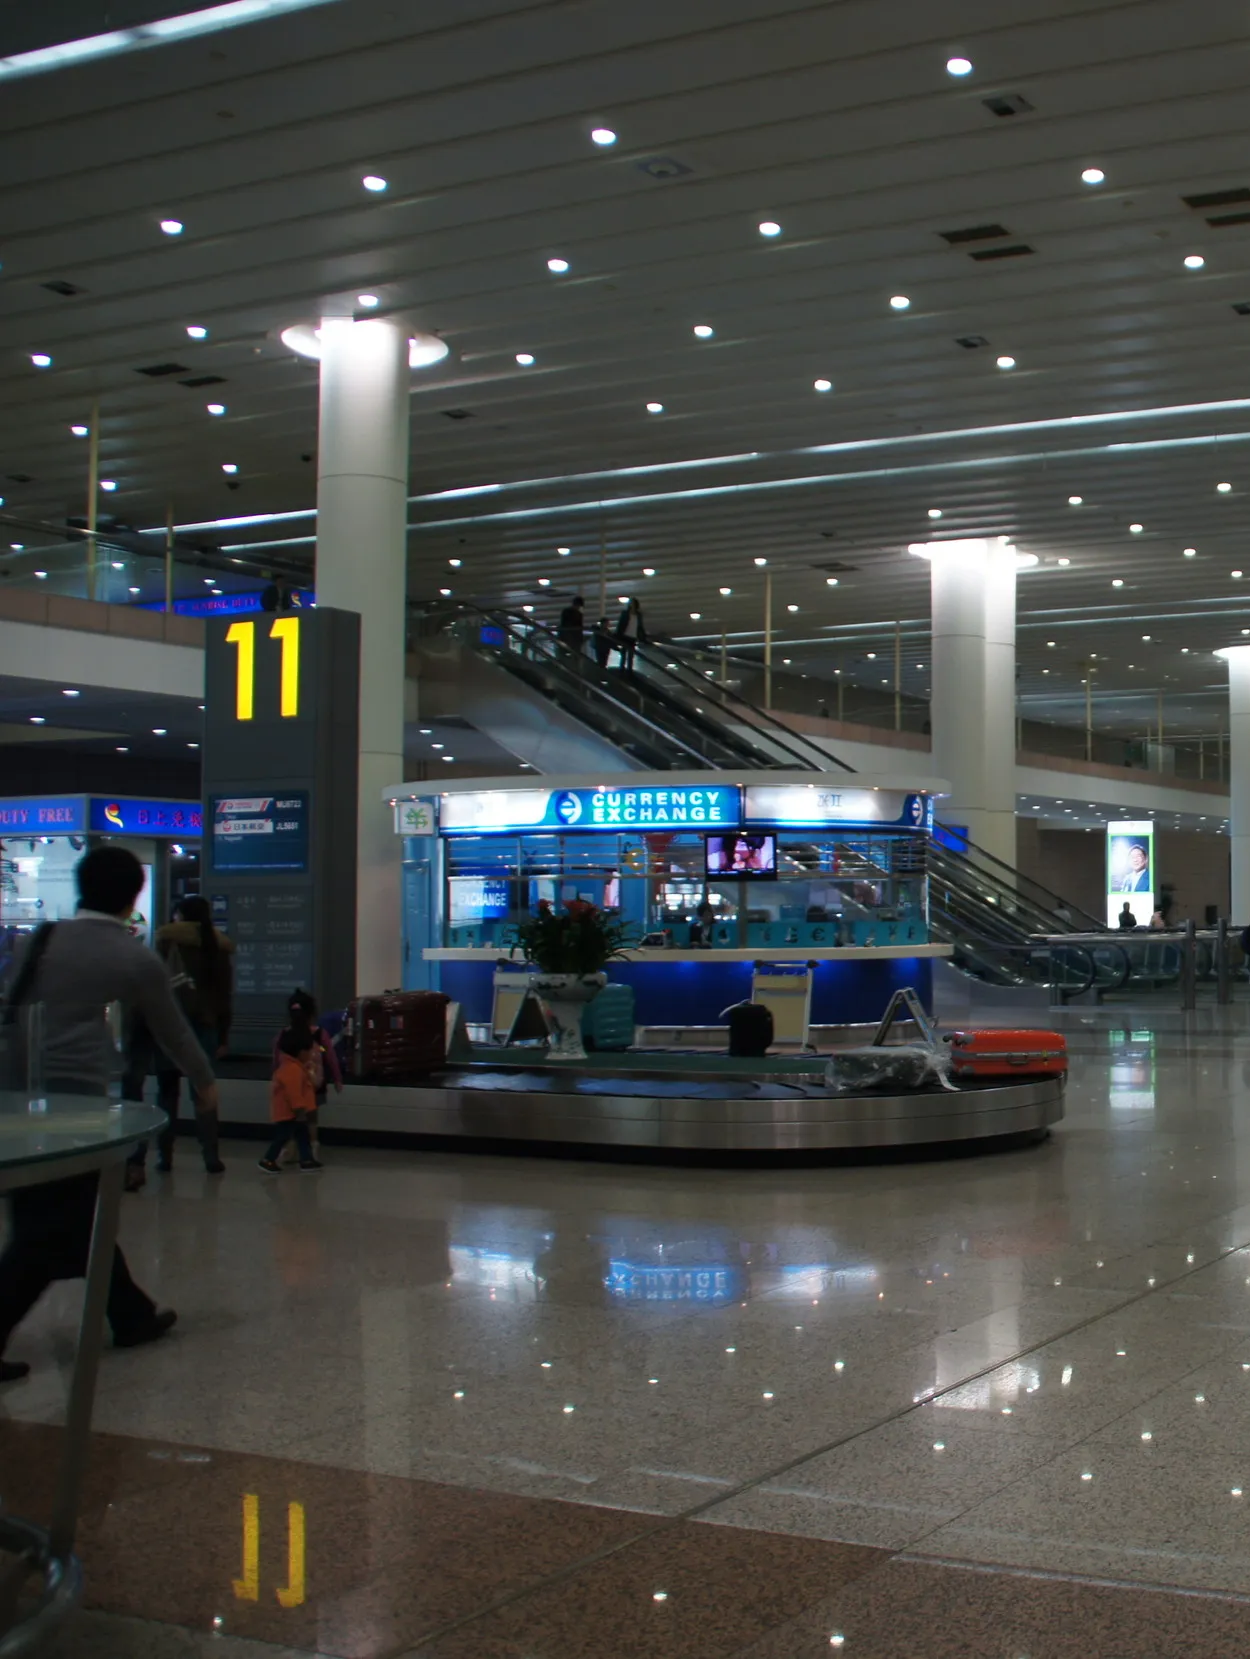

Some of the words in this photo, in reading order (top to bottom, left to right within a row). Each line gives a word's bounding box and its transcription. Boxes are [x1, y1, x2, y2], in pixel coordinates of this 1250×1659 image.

[225, 616, 299, 720] 11
[591, 791, 720, 808] CURRENCY
[38, 807, 74, 823] FREE
[592, 807, 722, 823] EXCHANGE
